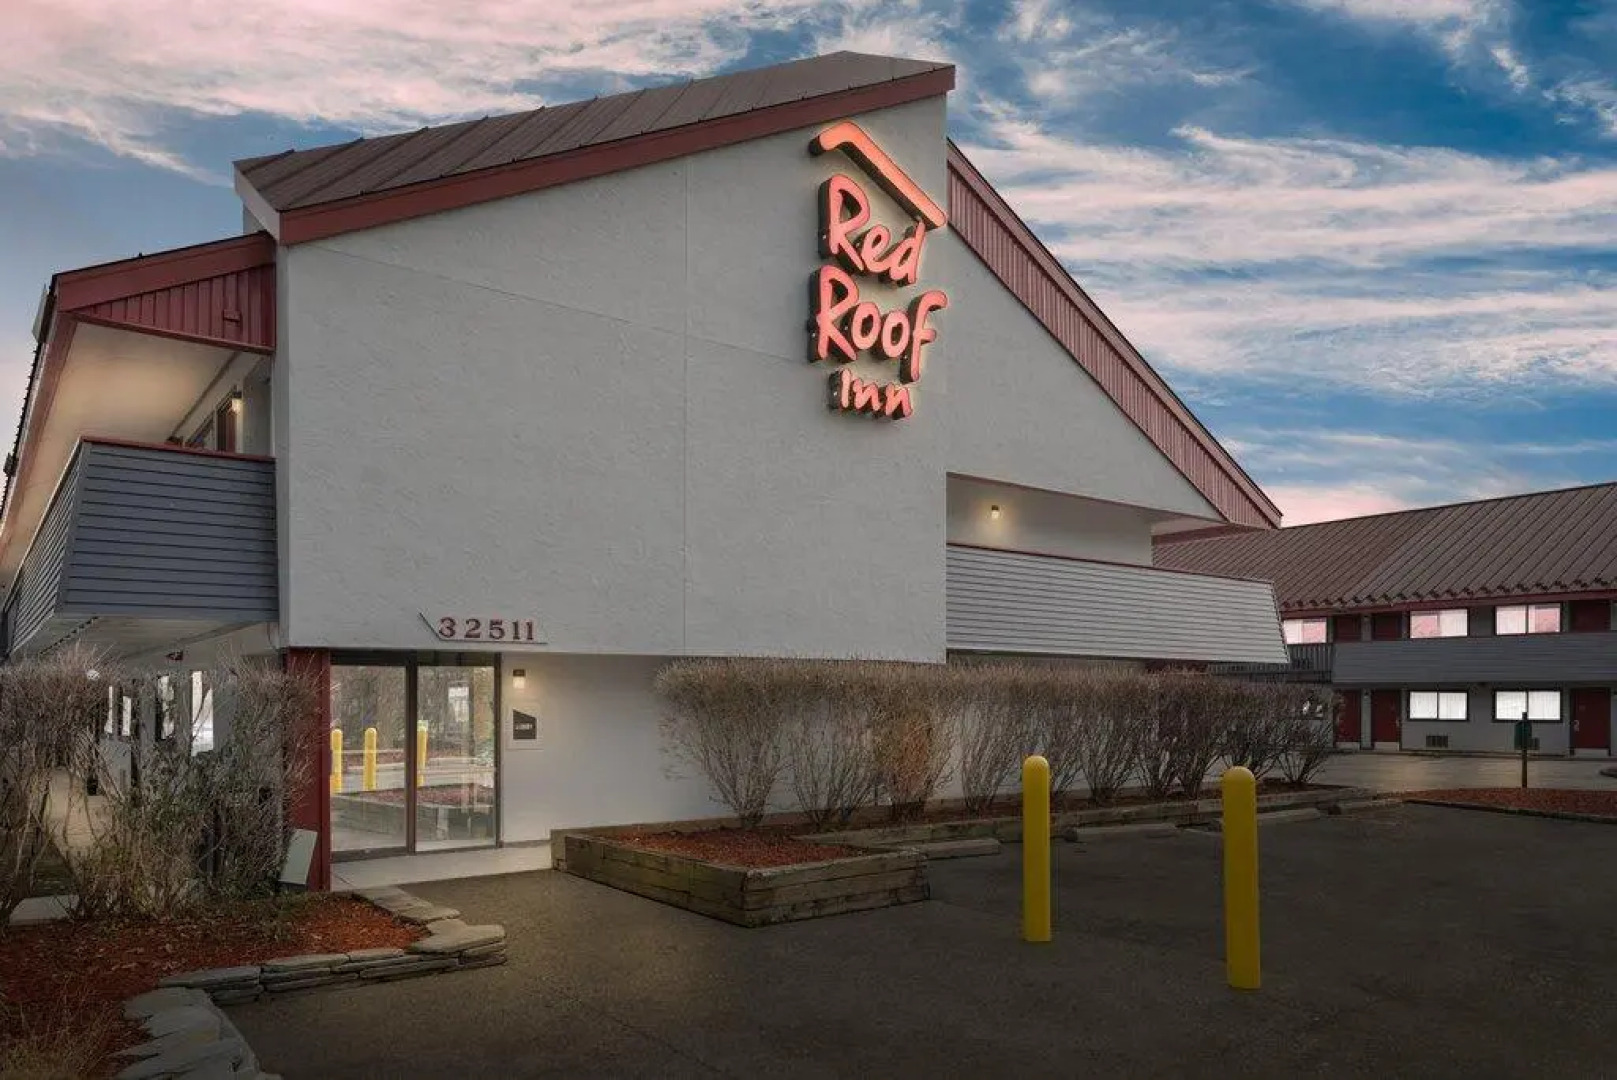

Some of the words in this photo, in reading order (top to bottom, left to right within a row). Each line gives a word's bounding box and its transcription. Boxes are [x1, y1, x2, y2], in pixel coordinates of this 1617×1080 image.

[823, 173, 926, 285] Red
[811, 264, 948, 382] Roof
[834, 368, 913, 418] Inn
[438, 616, 534, 641] 32511
